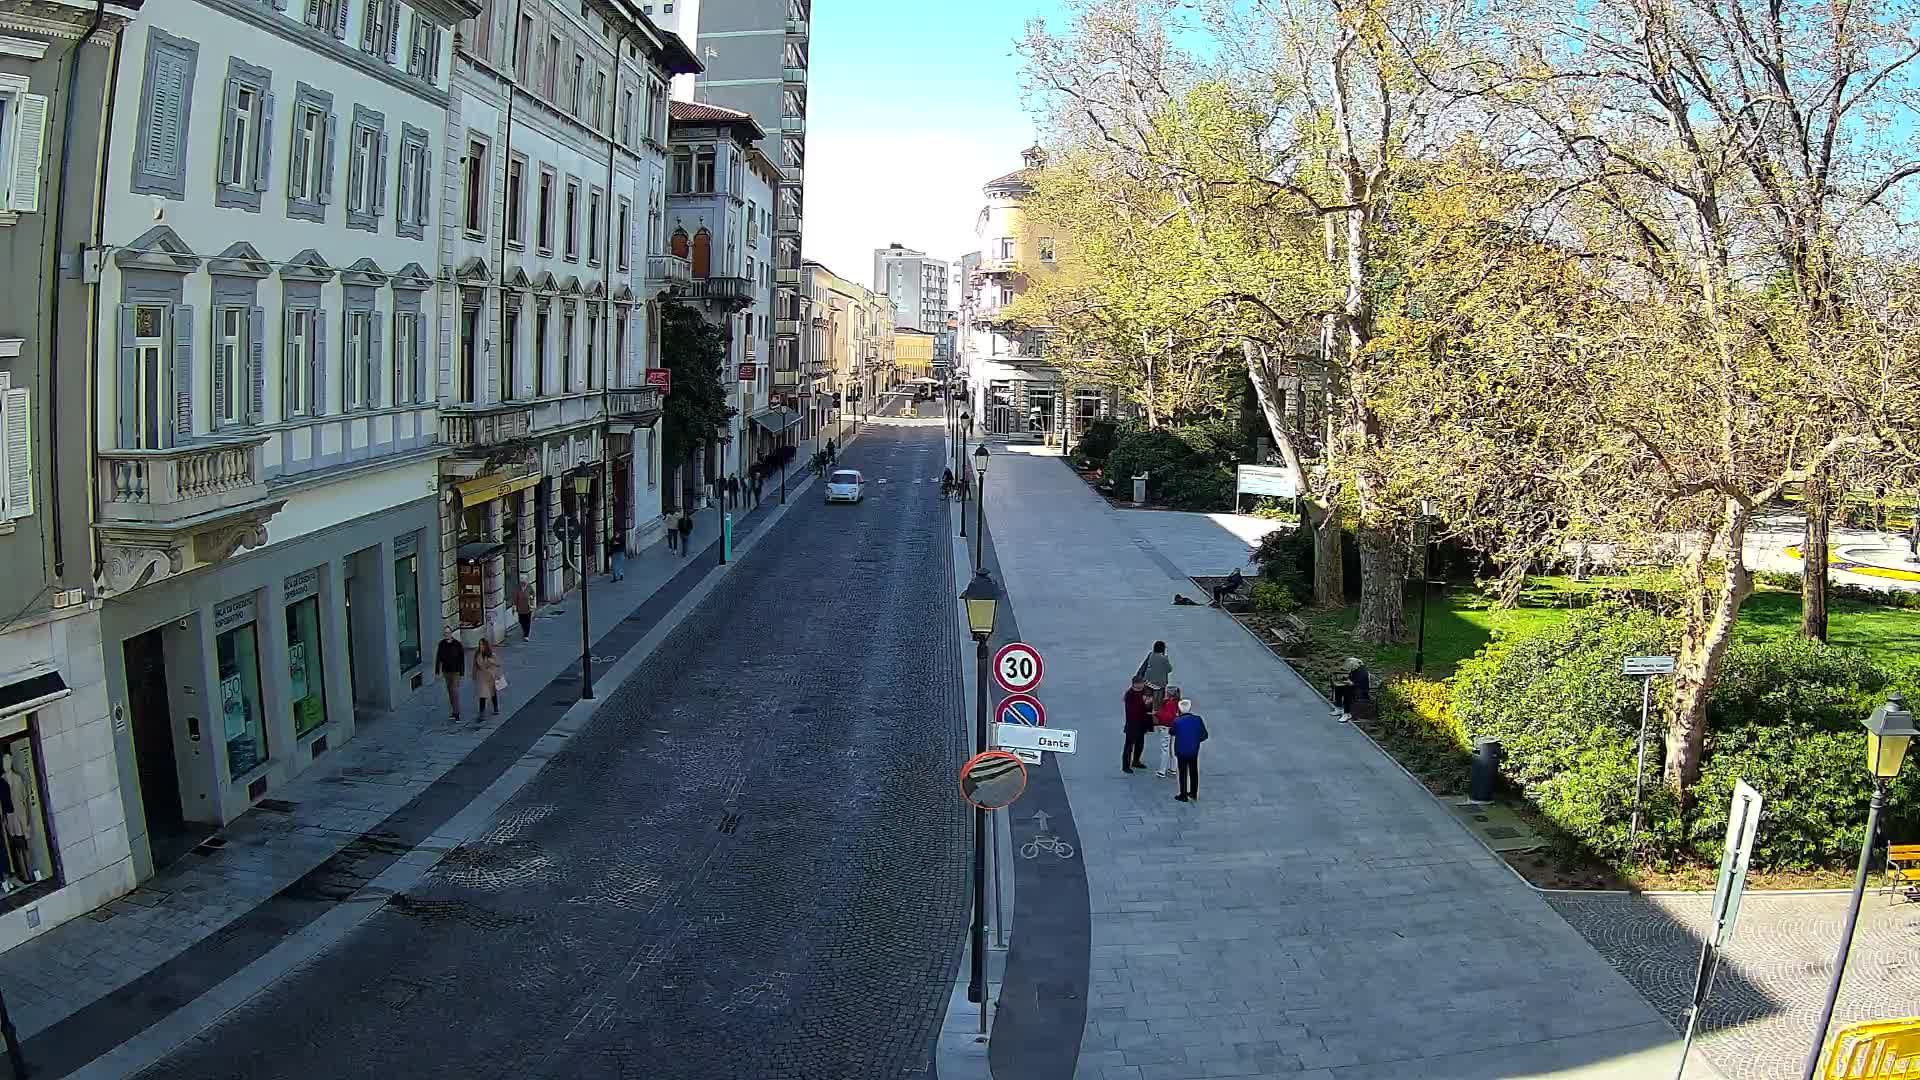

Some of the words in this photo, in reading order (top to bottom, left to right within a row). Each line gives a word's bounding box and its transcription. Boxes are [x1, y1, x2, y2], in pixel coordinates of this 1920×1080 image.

[1005, 657, 1033, 679] 30
[222, 677, 240, 703] 130
[1038, 737, 1070, 748] Dante
